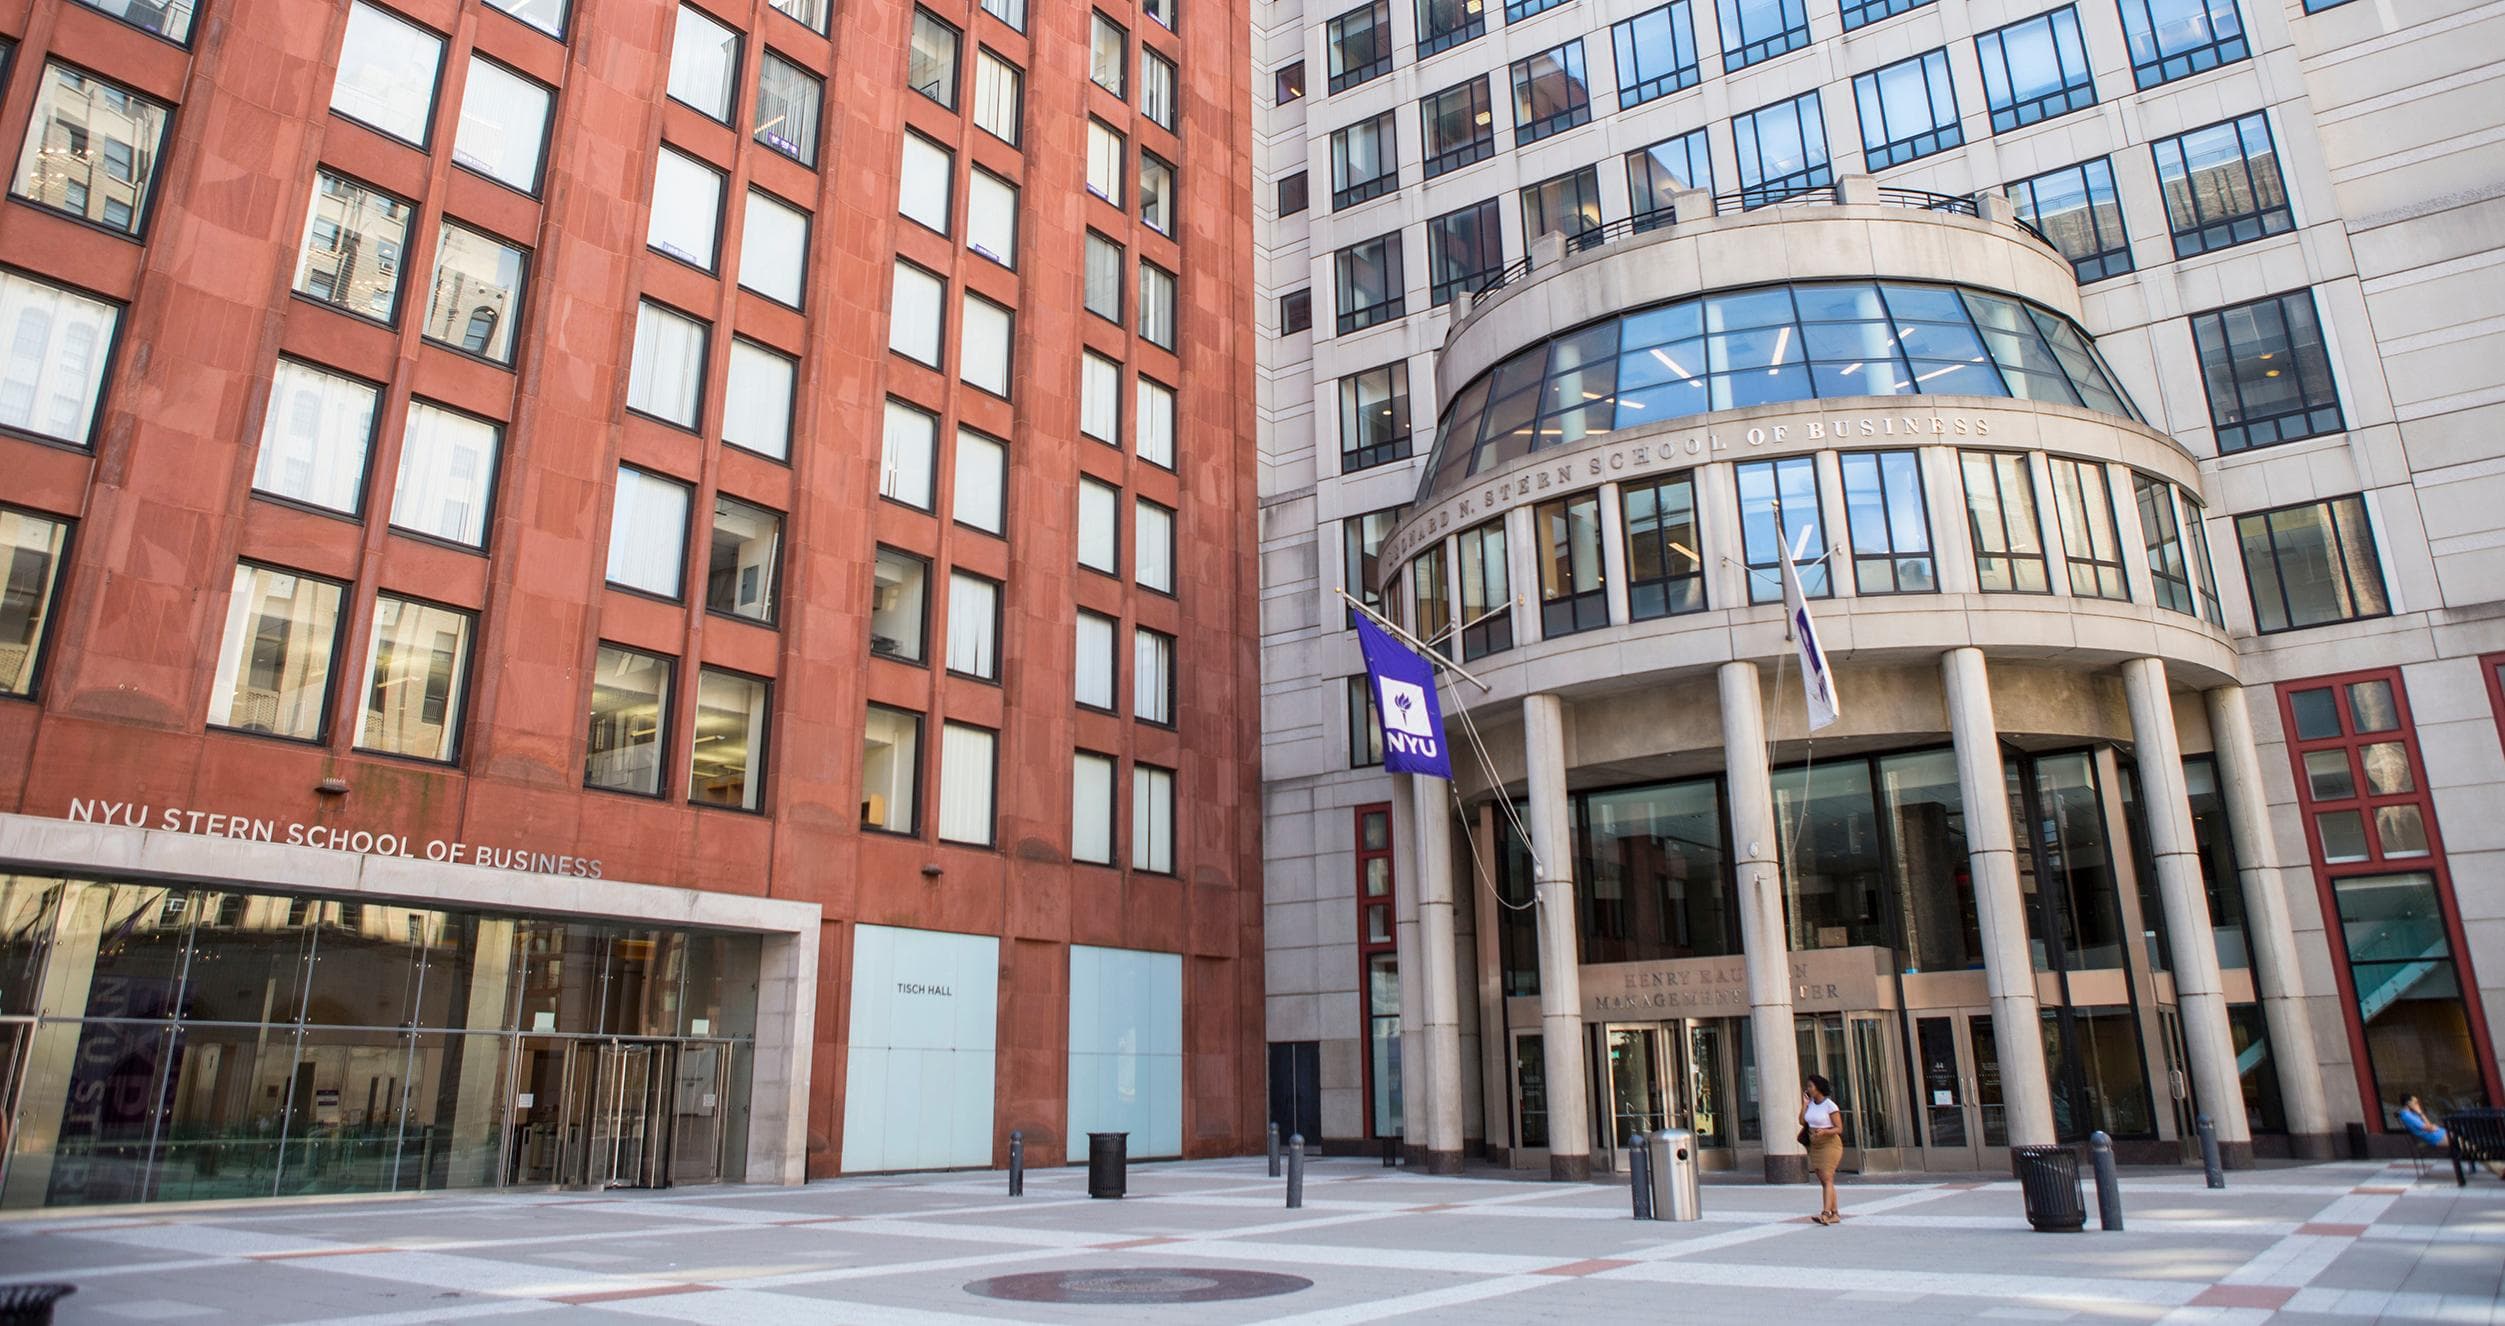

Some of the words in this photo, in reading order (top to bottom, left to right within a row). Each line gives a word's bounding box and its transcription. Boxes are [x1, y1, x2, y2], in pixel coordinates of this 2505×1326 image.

[1459, 499, 1475, 519] N.
[1484, 464, 1572, 508] STERN
[1589, 434, 1727, 475] SCHOOL
[1747, 423, 1788, 446] OF
[1807, 417, 1991, 440] BUSINESS
[1386, 731, 1437, 758] NYU
[68, 797, 149, 828] NYU
[161, 808, 275, 842] STERN
[286, 823, 414, 859] SCHOOL
[426, 839, 467, 864] OF
[475, 846, 603, 879] BUSINESS
[1624, 971, 1690, 988] HENRY
[1700, 962, 1808, 984] KAUN
[897, 983, 925, 994] TISCH
[928, 984, 952, 996] HALL
[1595, 986, 1743, 1011] MANAGEMENT
